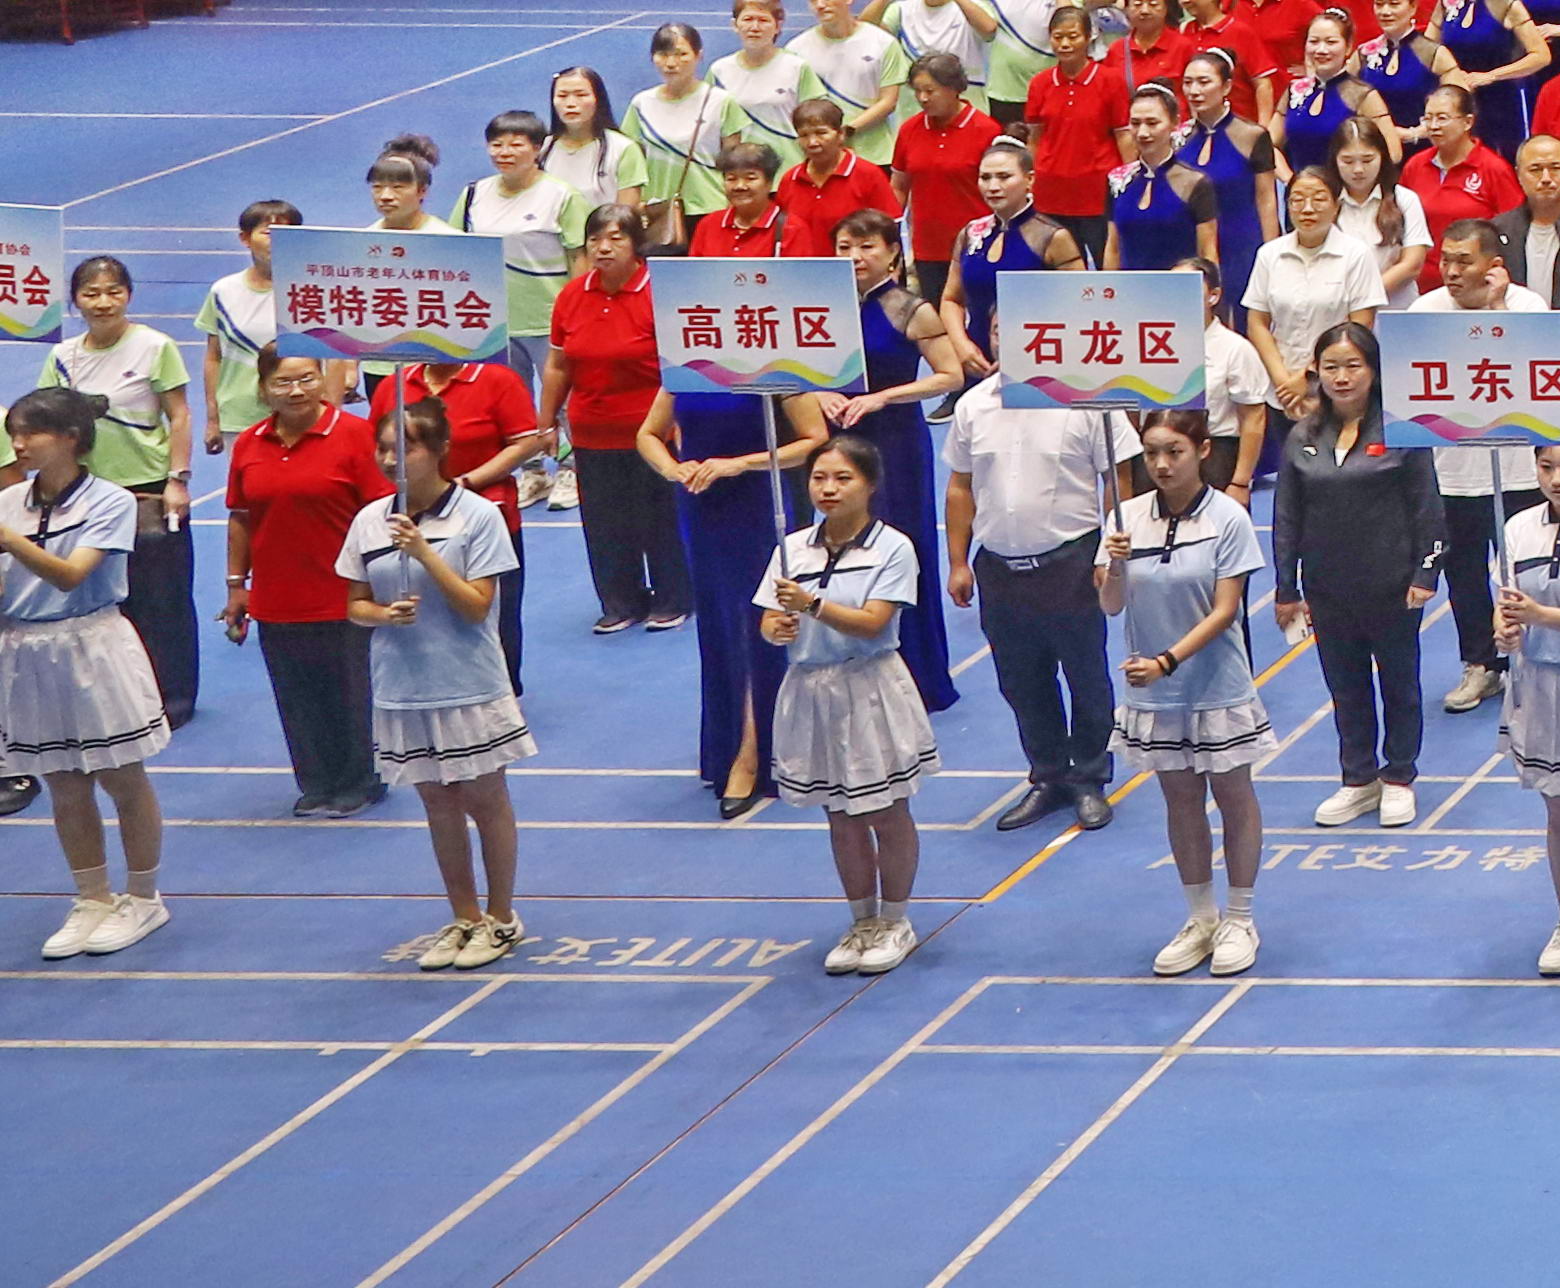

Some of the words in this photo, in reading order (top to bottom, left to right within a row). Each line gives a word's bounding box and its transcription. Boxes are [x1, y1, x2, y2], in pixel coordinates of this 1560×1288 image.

[306, 263, 472, 283] 平顶山市老年人体育协会
[287, 283, 492, 330] 模特委员会
[679, 304, 837, 349] 高新区
[1023, 319, 1180, 365] 石龙区
